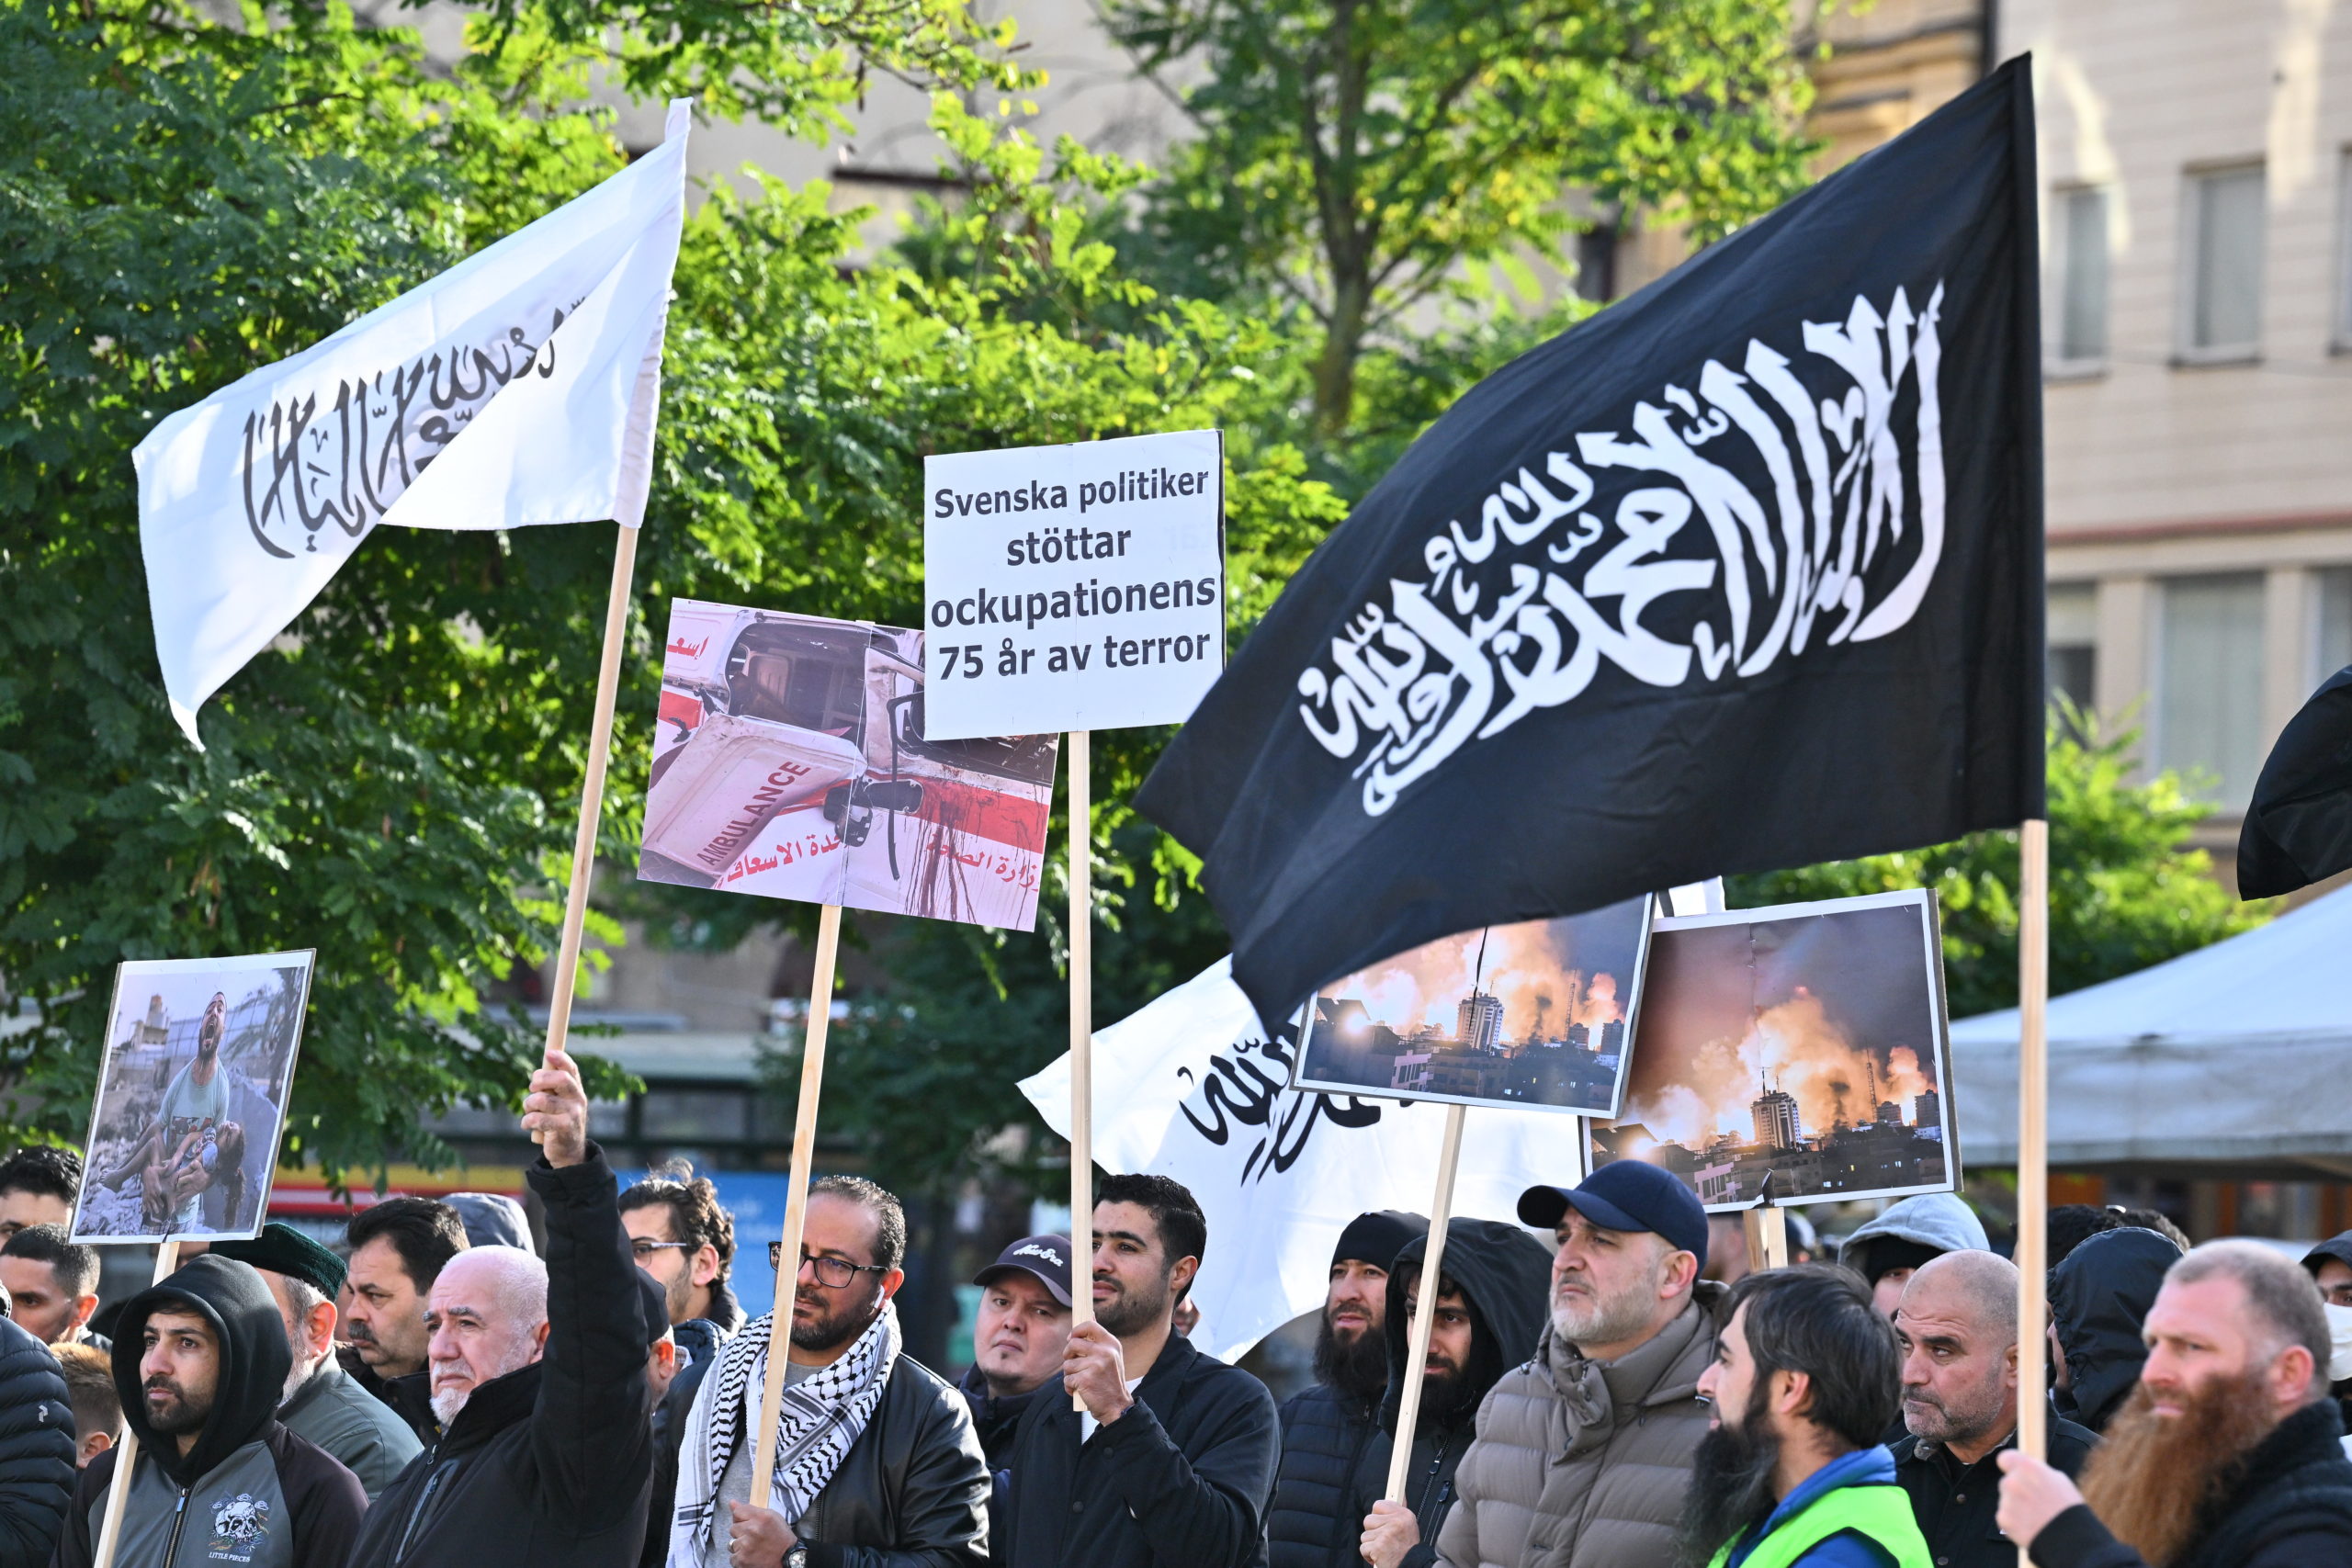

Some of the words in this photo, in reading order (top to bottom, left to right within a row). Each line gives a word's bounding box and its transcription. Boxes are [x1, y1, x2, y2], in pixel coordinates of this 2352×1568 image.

[934, 480, 1068, 518] Svenska
[1080, 468, 1209, 513] politiker
[1007, 527, 1131, 567] stöttar
[931, 579, 1216, 630] ockupationens
[939, 644, 984, 681] 75
[998, 637, 1035, 677] år
[1047, 644, 1091, 672] av
[1103, 634, 1211, 669] terror
[696, 761, 811, 865] AMBULANCE
[995, 855, 1039, 893] زارة
[209, 1551, 228, 1560] LITTLE
